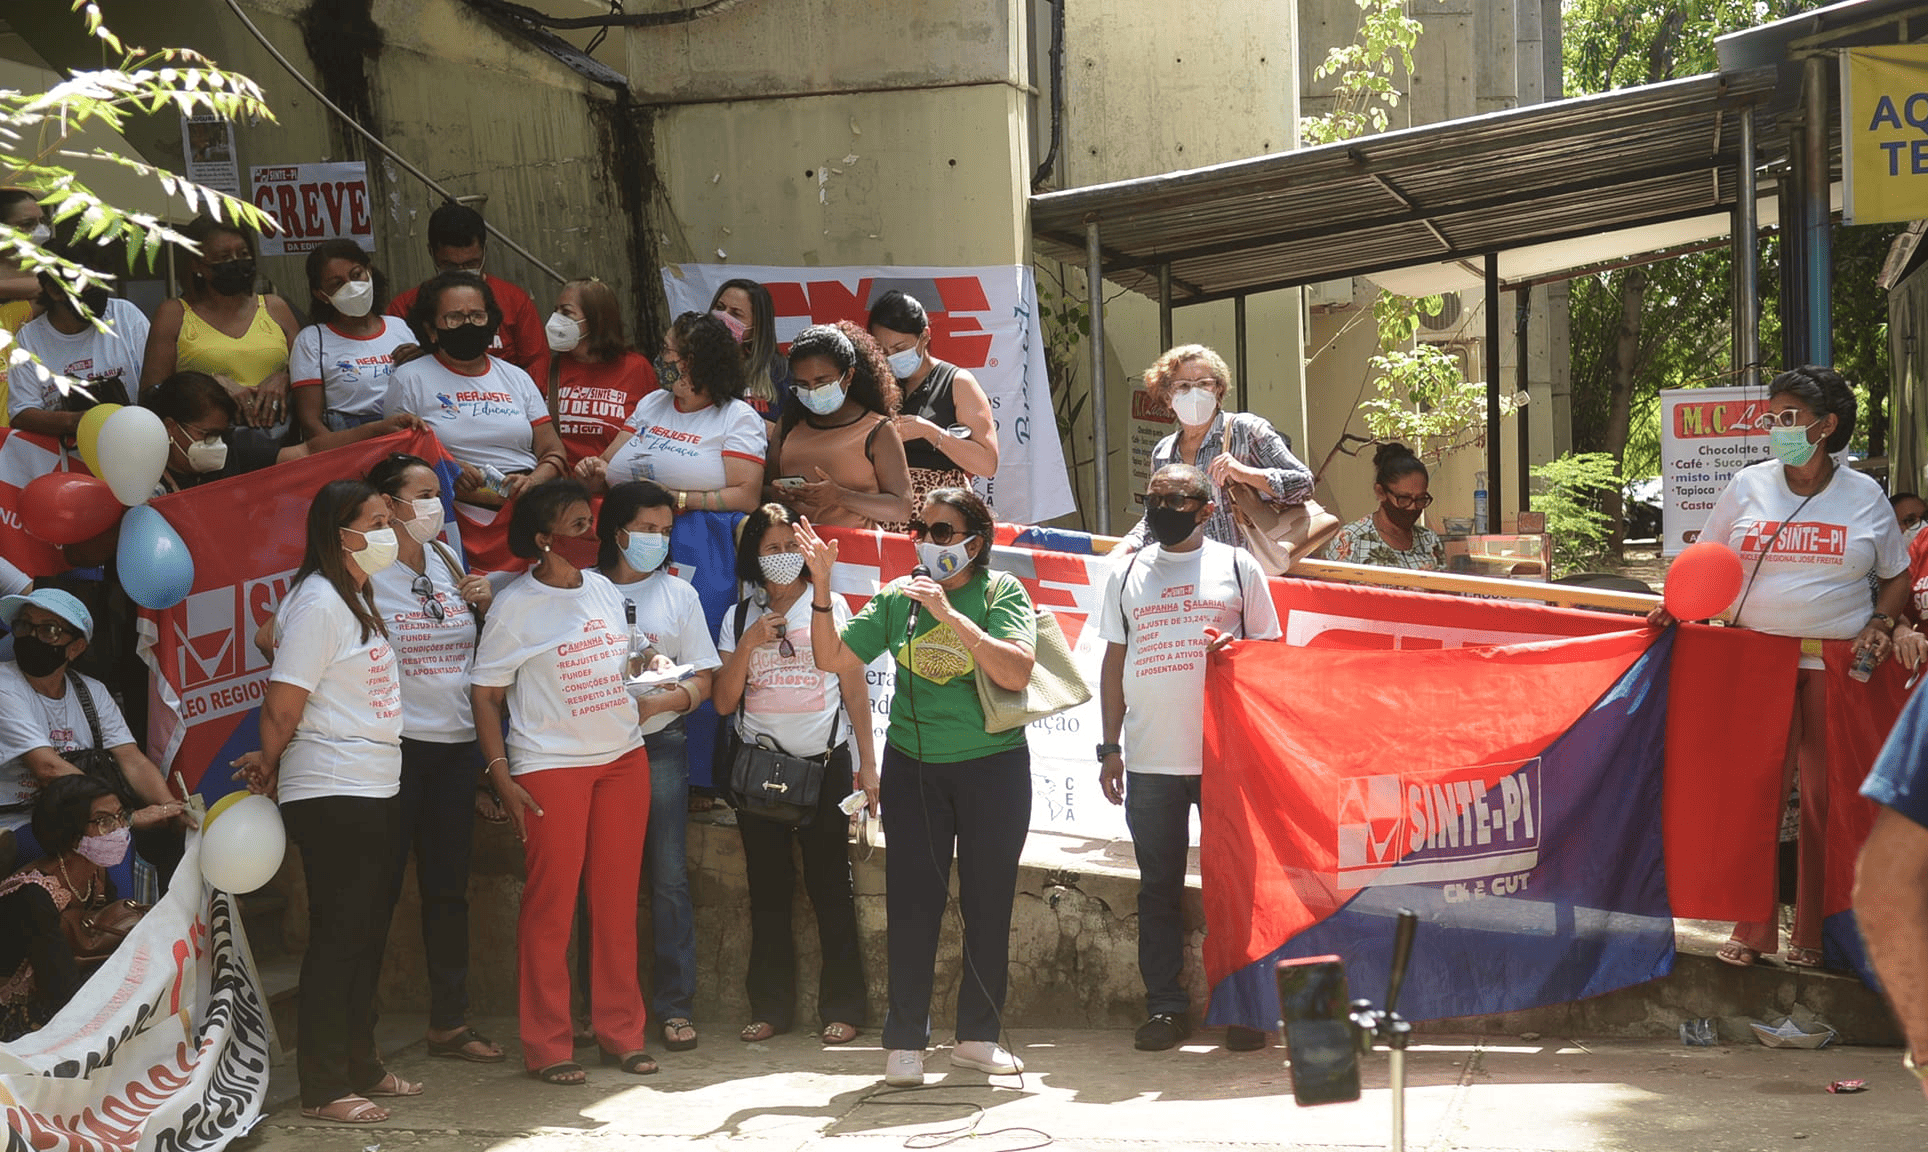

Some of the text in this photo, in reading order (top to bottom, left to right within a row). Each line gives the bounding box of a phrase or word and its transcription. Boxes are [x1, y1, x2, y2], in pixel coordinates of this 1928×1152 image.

[254, 181, 371, 238] GREVE
[456, 391, 512, 403] REAJUSTE
[571, 400, 590, 414] DE
[592, 401, 625, 419] LUTA
[1682, 405, 1727, 435] M.C
[649, 425, 702, 444] REAJUSTE
[1698, 444, 1759, 455] Chocolate
[1675, 459, 1703, 469] Café
[1714, 458, 1742, 468] Suco
[1675, 472, 1710, 482] misto
[1675, 485, 1715, 497] Tapioca
[1680, 501, 1716, 510] Casta
[1777, 526, 1843, 553] SINTE-PI
[1133, 599, 1226, 620] CAMPANHA SALARIAL
[557, 636, 603, 656] CAMPANHA
[1175, 651, 1204, 659] ATIVOS
[560, 654, 598, 668] REAJUSTE
[600, 650, 610, 660] DE
[610, 673, 620, 682] DE
[1141, 663, 1195, 676] APOSENTADOS
[1408, 772, 1535, 853] SINTE-PI
[1491, 872, 1530, 896] CUT
